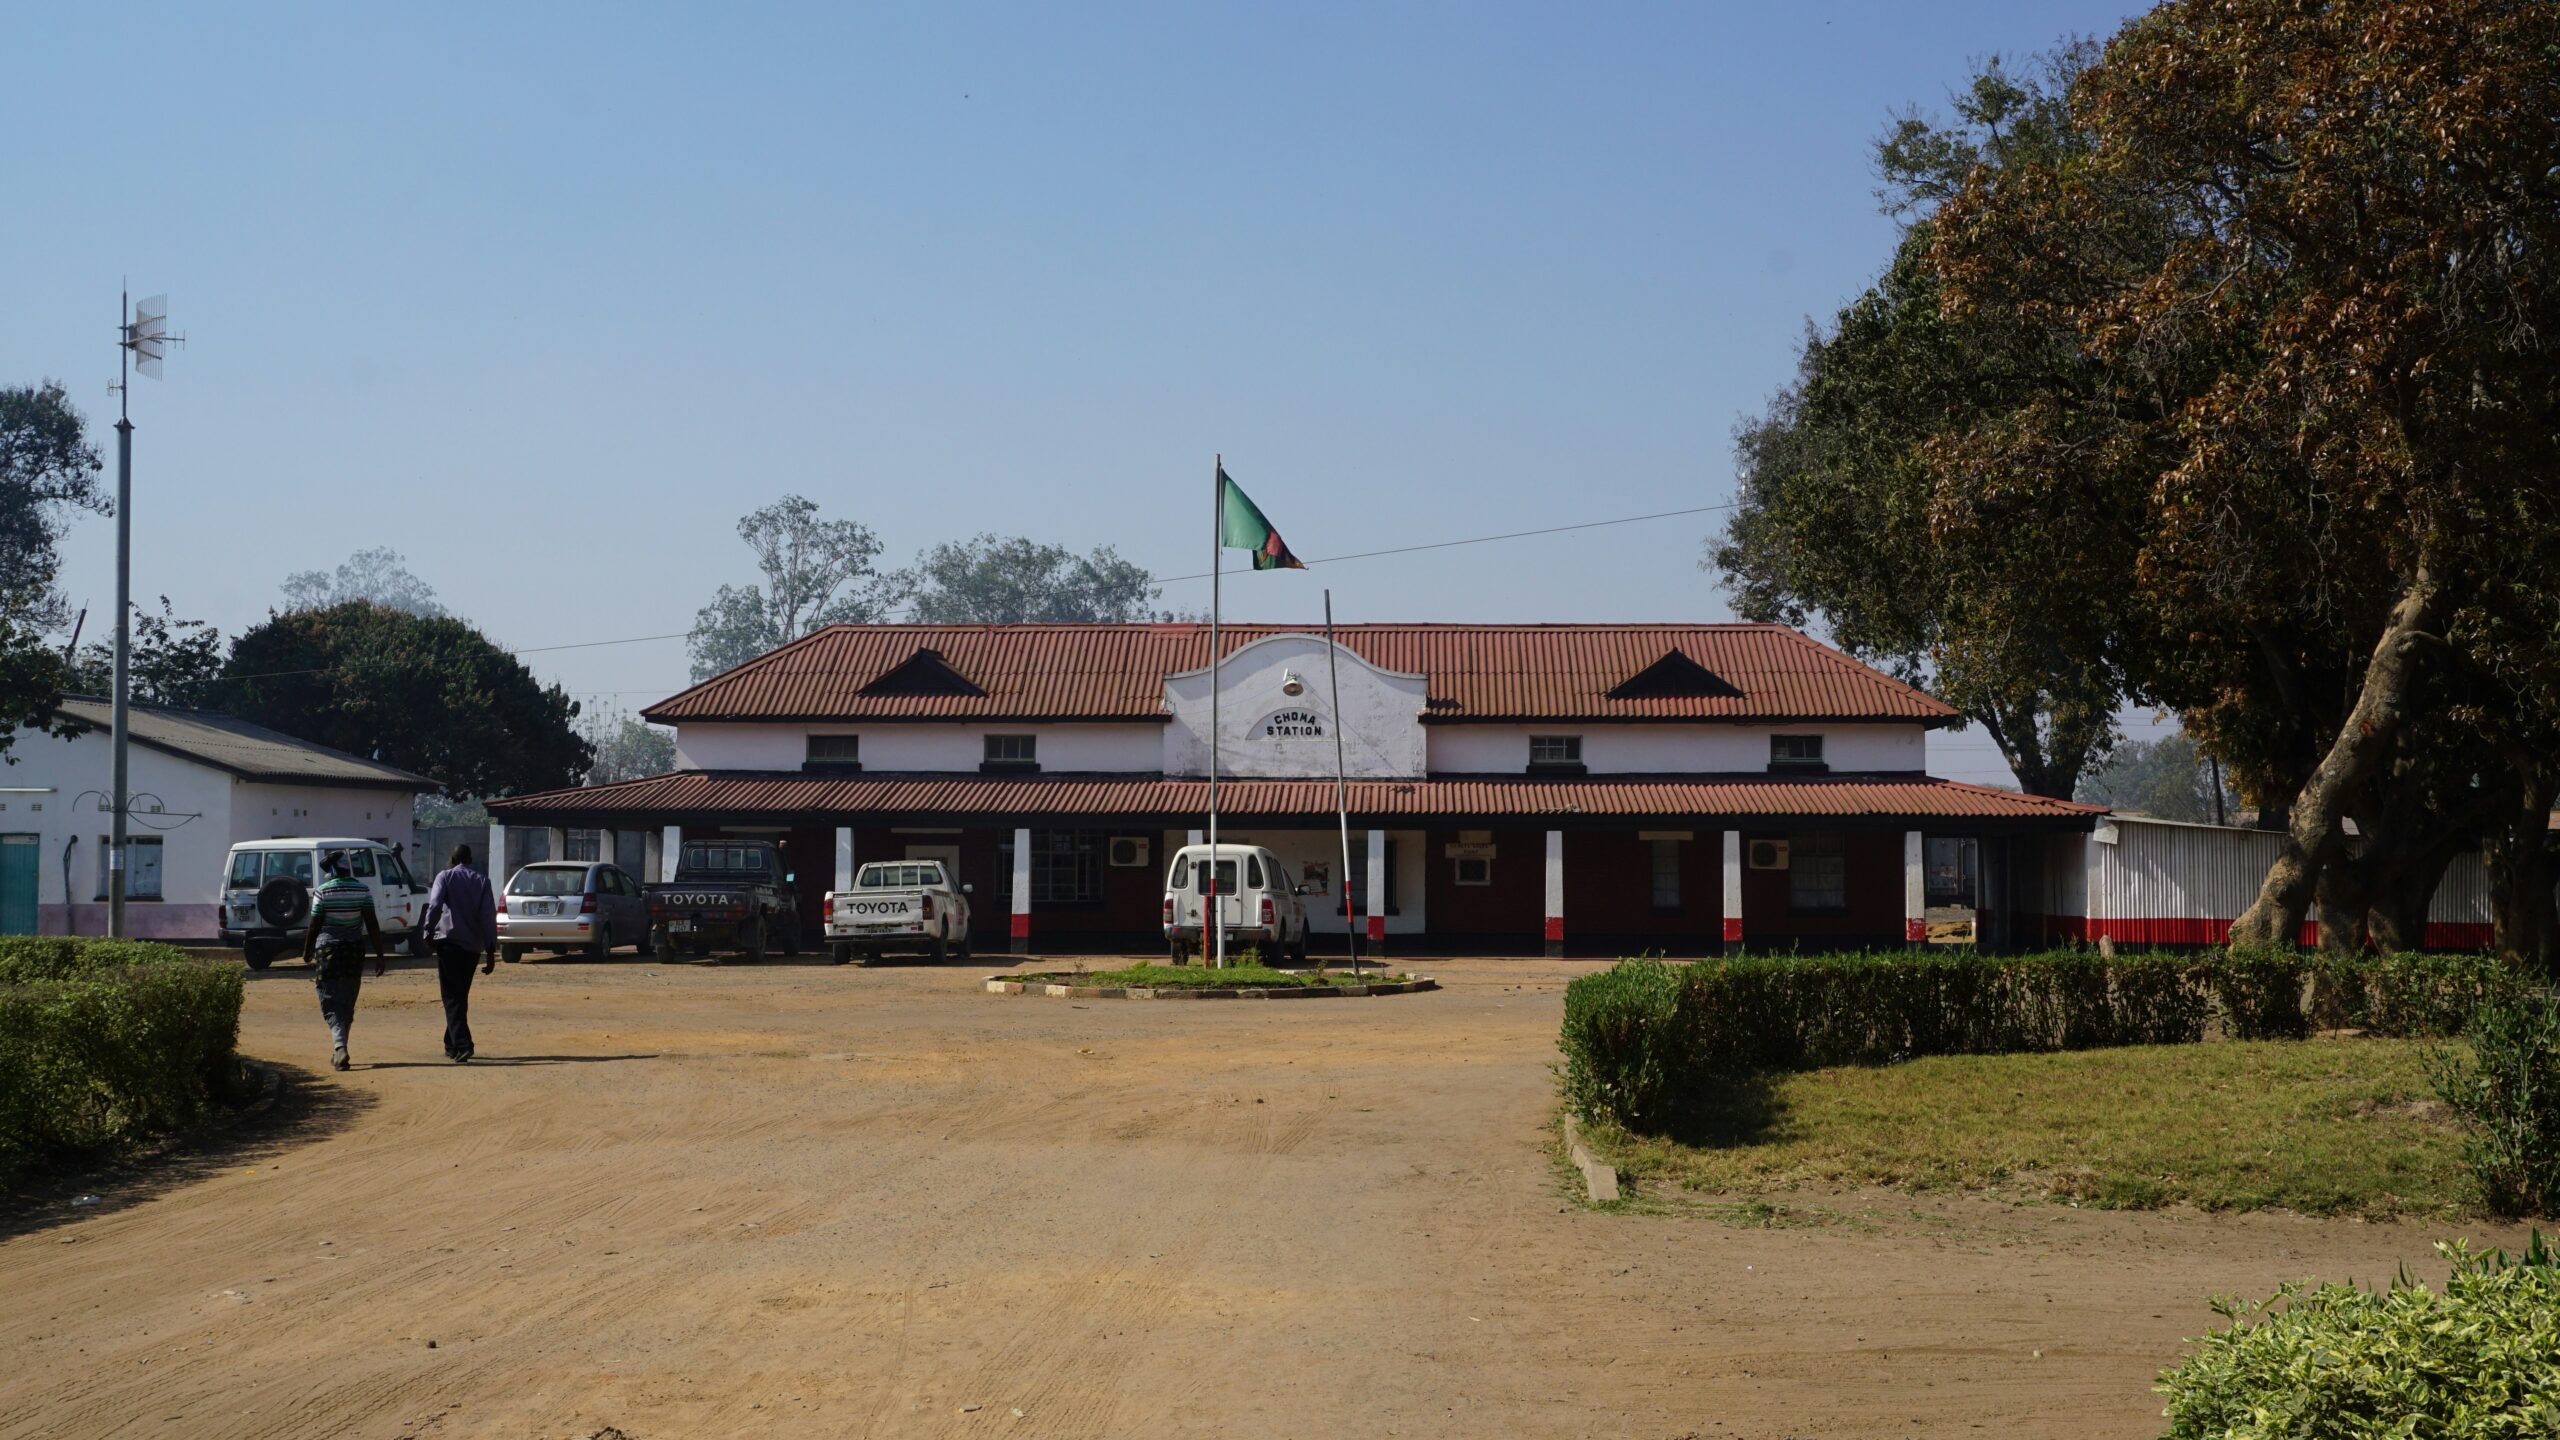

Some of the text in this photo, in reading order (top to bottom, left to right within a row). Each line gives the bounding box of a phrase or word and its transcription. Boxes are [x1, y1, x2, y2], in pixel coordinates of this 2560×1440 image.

[1274, 712, 1316, 725] CHOMA
[1267, 726, 1322, 736] STATION
[662, 894, 728, 905] TOYOTA
[847, 902, 908, 914] TOYOTA
